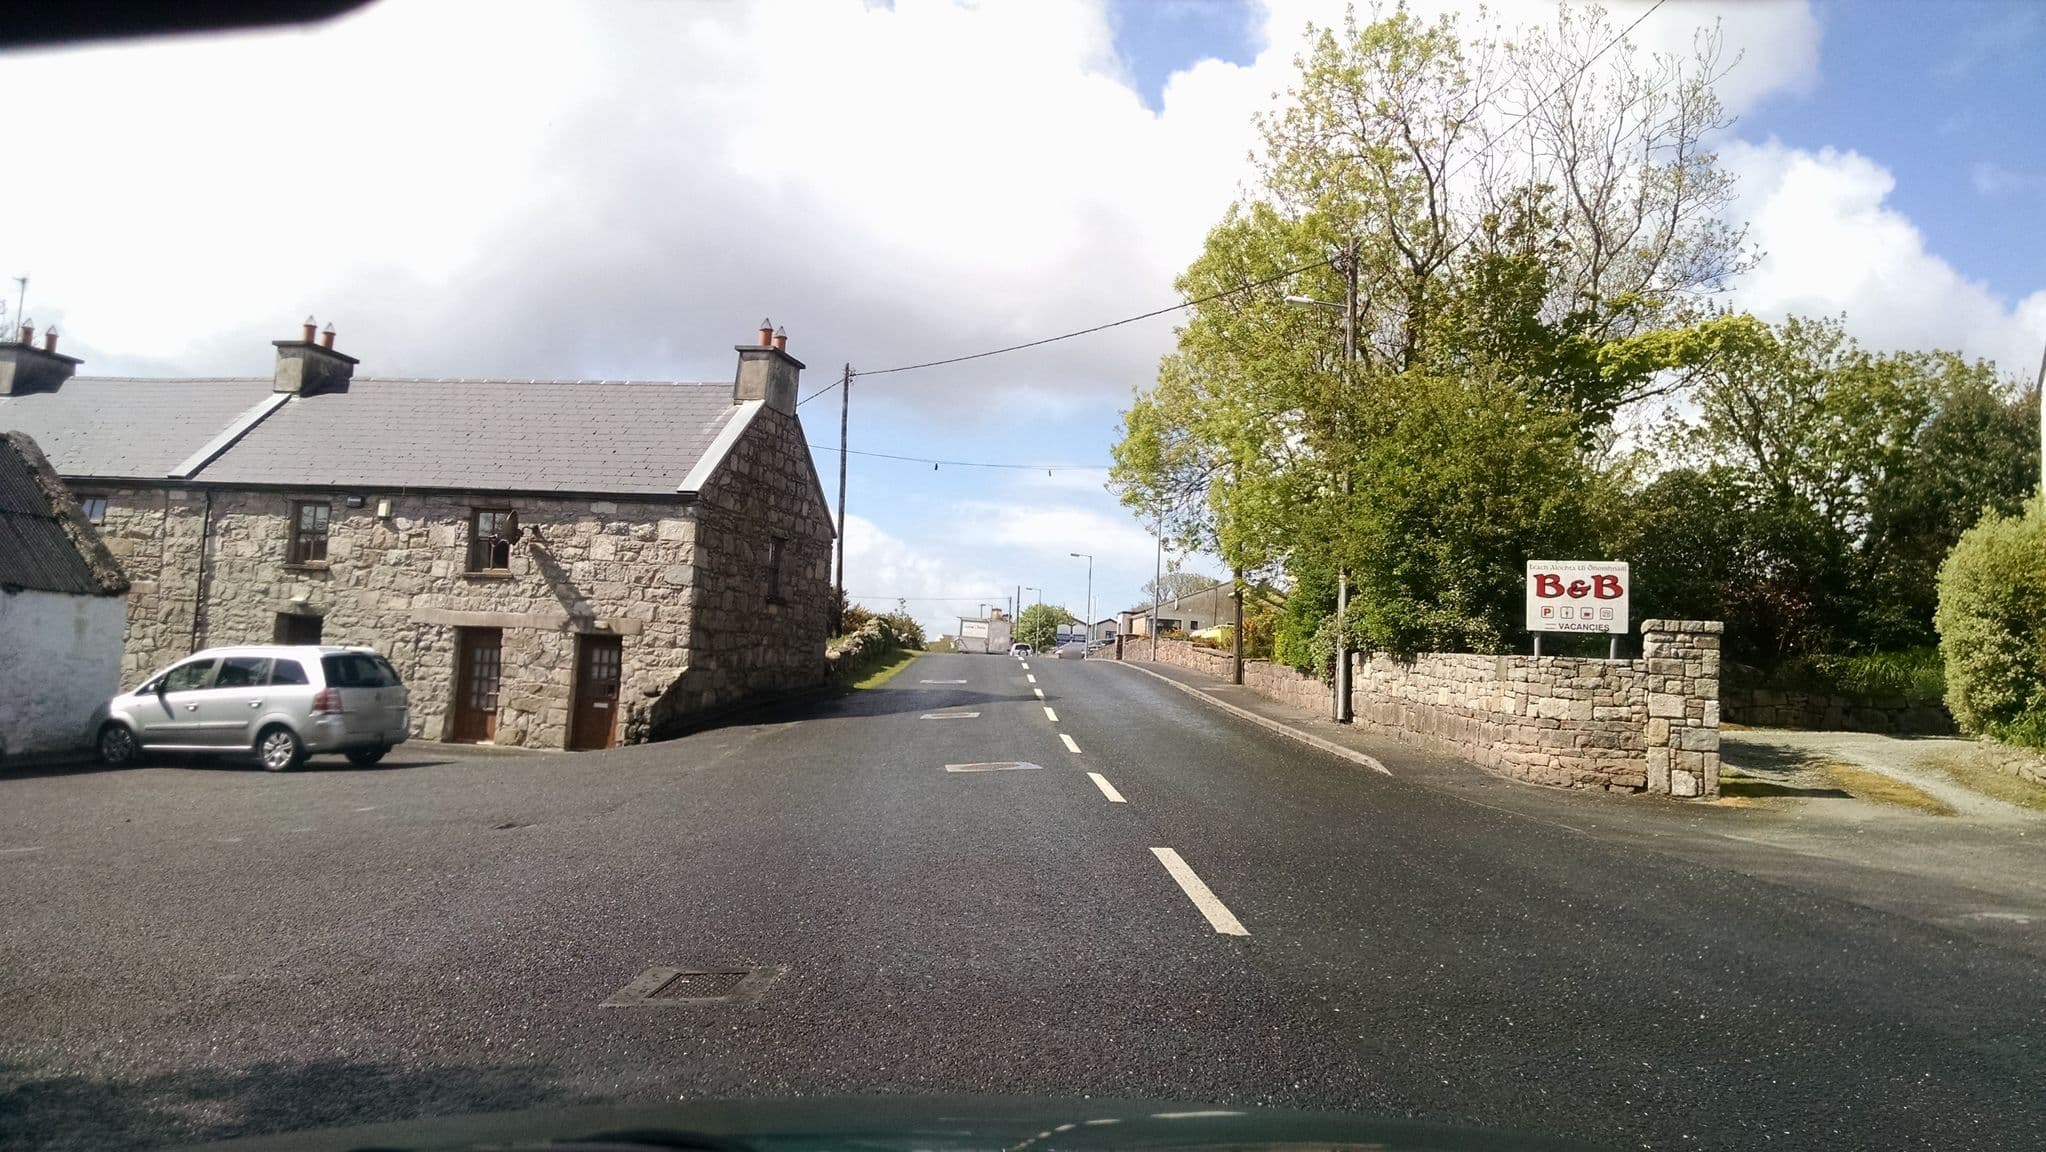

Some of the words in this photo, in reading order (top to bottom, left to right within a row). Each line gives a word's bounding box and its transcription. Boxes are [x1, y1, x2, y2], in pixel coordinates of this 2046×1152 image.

[1533, 573, 1624, 600] B&B
[1544, 608, 1551, 616] P
[1558, 622, 1610, 632] VACANCIES
